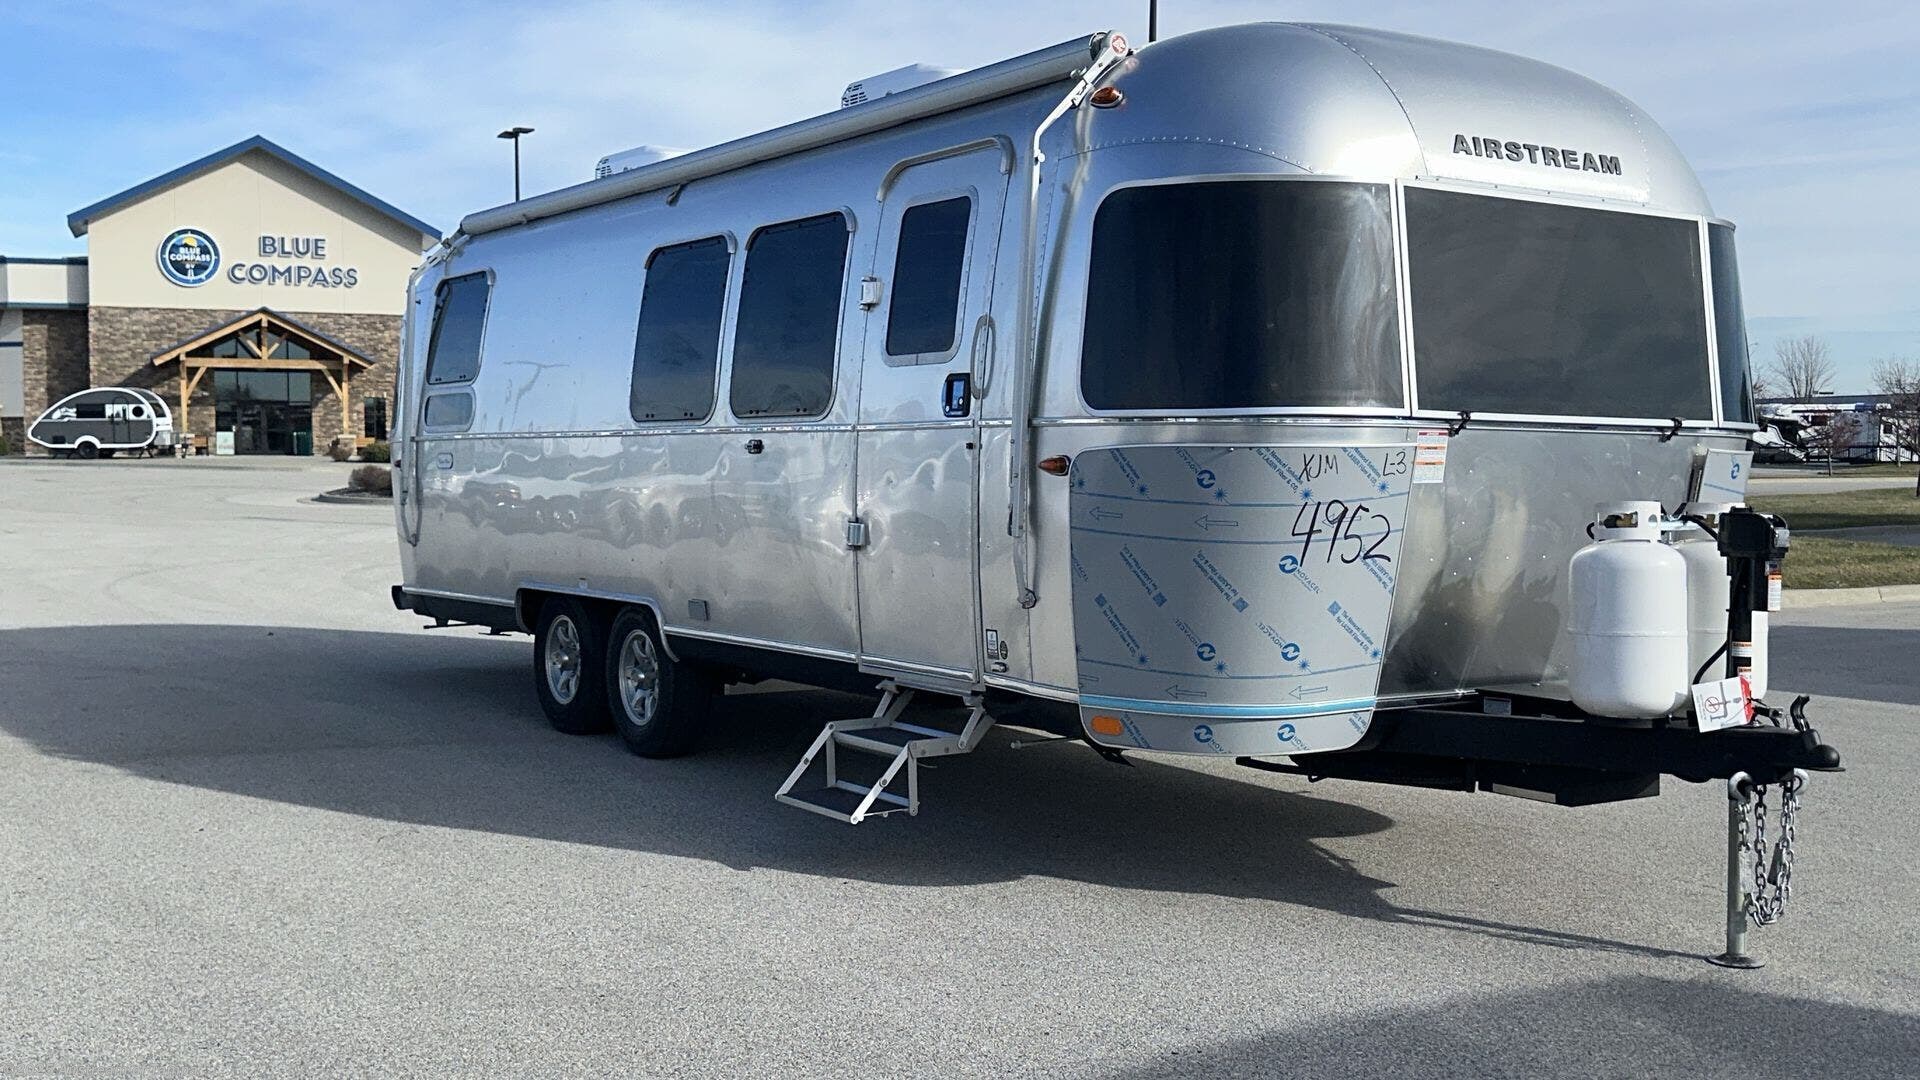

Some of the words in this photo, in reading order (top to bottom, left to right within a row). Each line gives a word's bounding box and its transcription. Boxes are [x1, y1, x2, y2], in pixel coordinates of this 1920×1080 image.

[1453, 134, 1622, 176] AIRSTREAM
[170, 253, 211, 262] COMPASS
[179, 247, 201, 255] BLUE
[259, 236, 326, 259] BLUE
[228, 263, 359, 288] COMPASS
[1291, 500, 1391, 568] 4952
